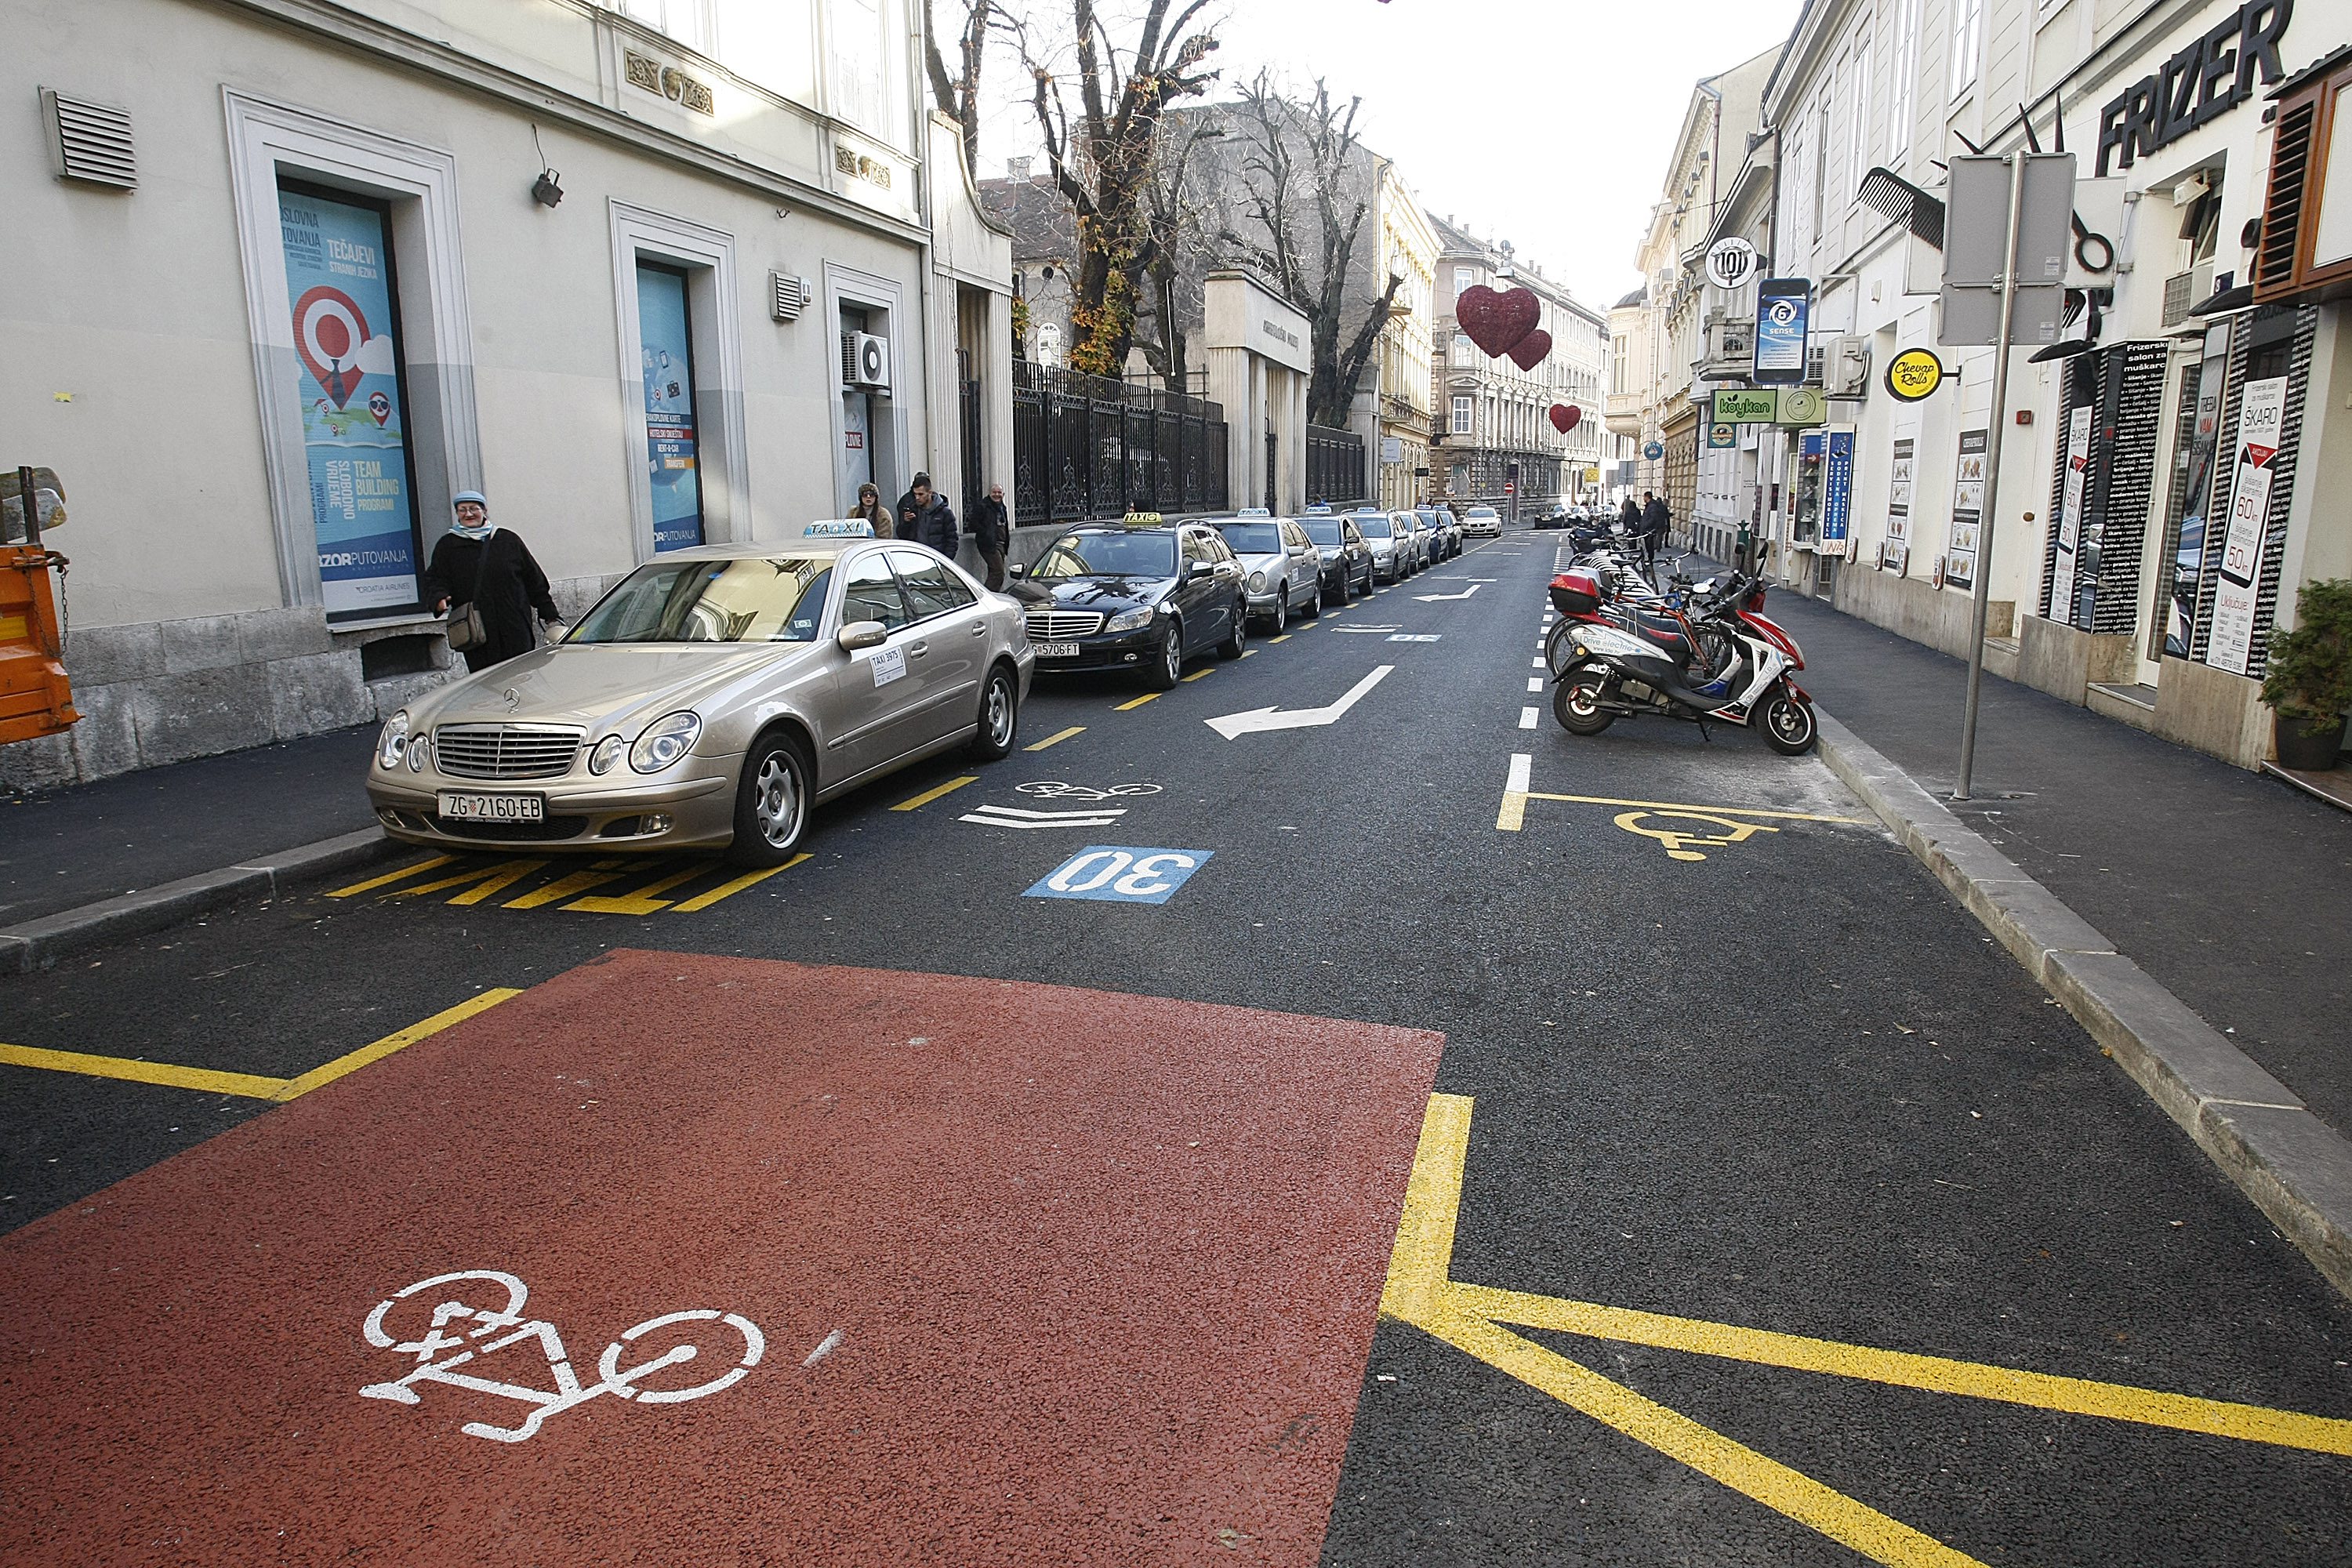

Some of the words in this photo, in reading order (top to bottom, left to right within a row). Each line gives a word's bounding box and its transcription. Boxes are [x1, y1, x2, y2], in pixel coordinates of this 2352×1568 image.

[2094, 0, 2294, 177] FRIZER
[327, 238, 376, 266] TEČAJEVI
[1720, 251, 1744, 274] 101
[1777, 308, 1786, 318] 6
[1894, 361, 1934, 375] Chevap
[1900, 372, 1931, 387] Rolls
[2245, 405, 2278, 426] ŠKARO
[353, 460, 382, 477] TEAM
[326, 460, 342, 508] VRIJEME
[338, 460, 355, 520] SLOBODNO
[355, 479, 399, 495] BUILDING
[1126, 513, 1149, 521] TAXI
[2236, 496, 2253, 520] 60
[2252, 510, 2258, 523] kn
[2227, 546, 2244, 570] 50
[2242, 561, 2248, 573] kn
[1584, 637, 1601, 645] Drive
[872, 655, 886, 666] TAXI
[886, 649, 899, 663] 3975
[448, 796, 467, 815] ZG
[1047, 851, 1196, 895] 30
